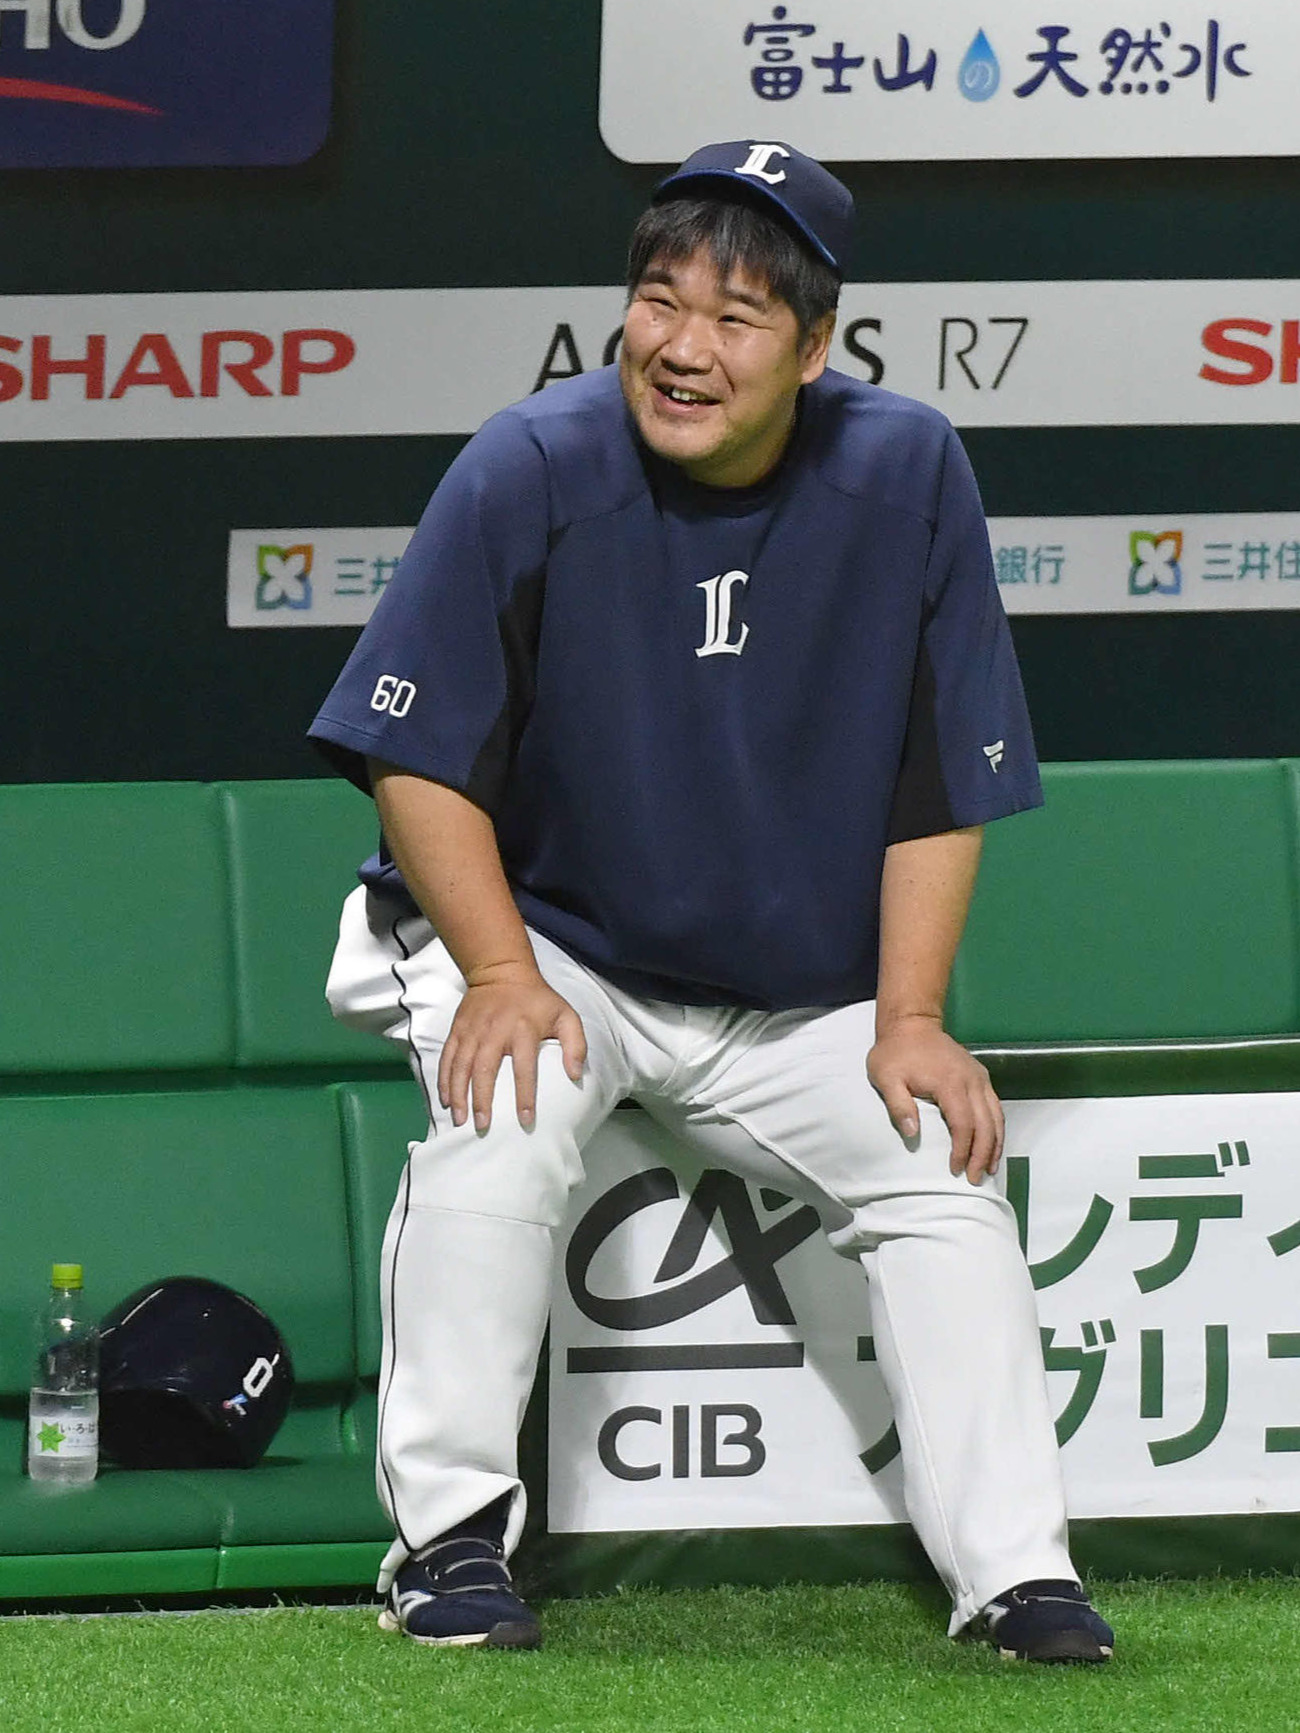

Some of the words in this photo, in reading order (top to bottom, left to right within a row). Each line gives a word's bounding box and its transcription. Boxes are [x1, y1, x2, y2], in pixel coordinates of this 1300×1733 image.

[938, 317, 1029, 391] R7
[1198, 317, 1300, 386] S
[695, 570, 750, 657] L
[370, 674, 416, 718] 60
[597, 1403, 766, 1481] CIB
